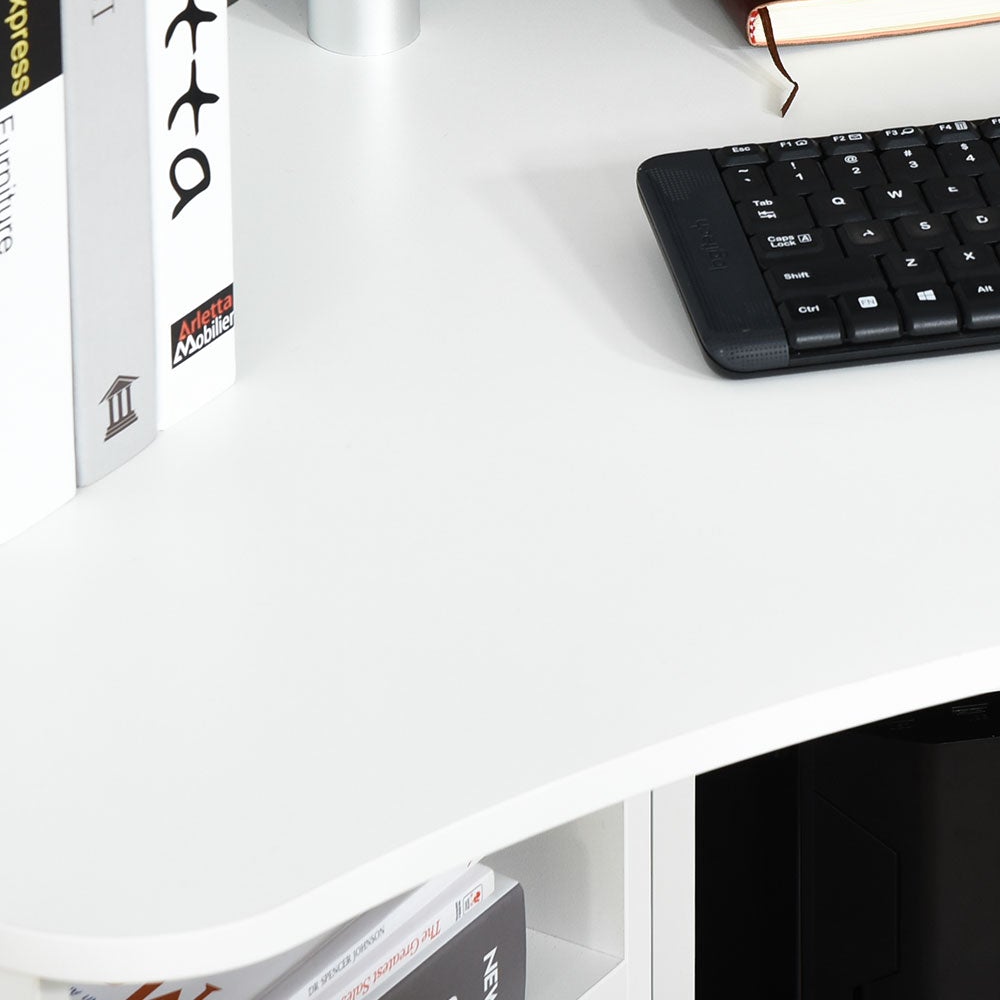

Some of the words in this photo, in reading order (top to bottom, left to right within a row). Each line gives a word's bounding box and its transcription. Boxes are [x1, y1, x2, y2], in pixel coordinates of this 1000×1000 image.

[844, 155, 858, 163] @
[887, 190, 902, 198] W
[832, 197, 846, 205] Q
[770, 240, 796, 248] Lock
[963, 252, 975, 260] X
[906, 258, 918, 267] Z
[978, 285, 993, 293] Alt
[799, 305, 819, 313] Ctrl
[179, 294, 233, 341] Arletta
